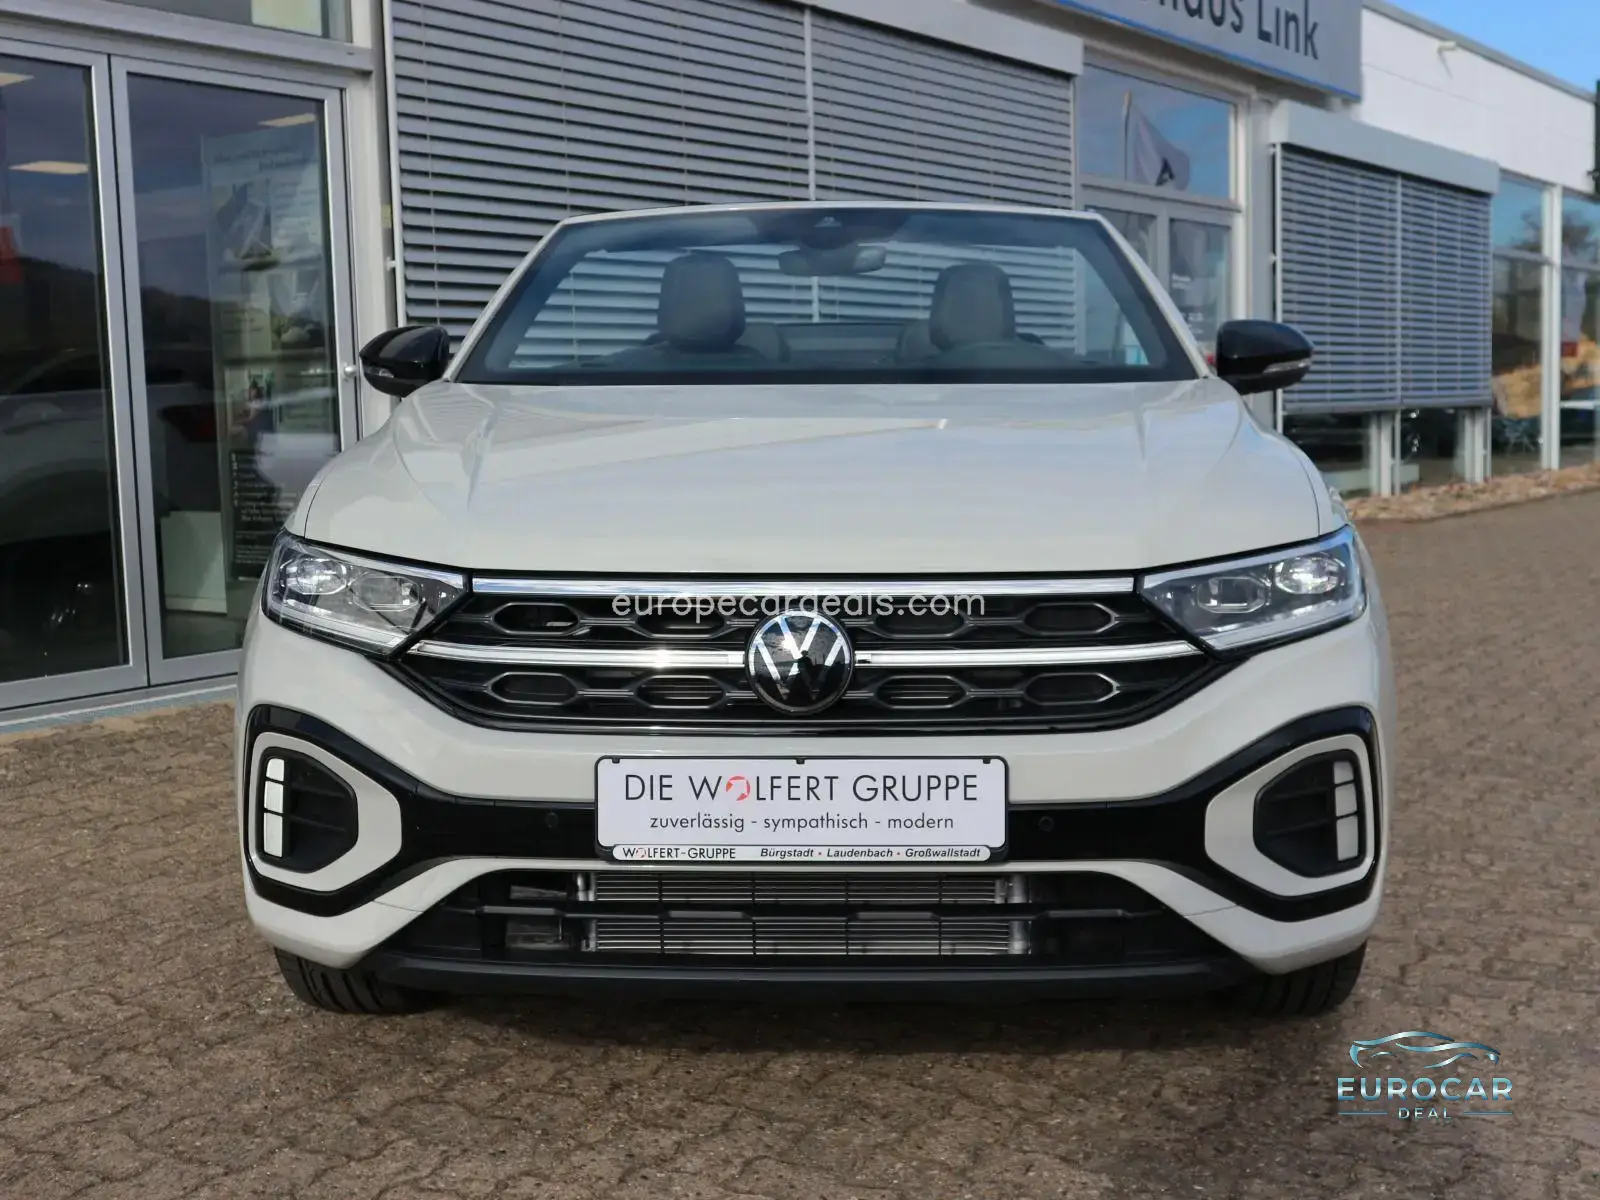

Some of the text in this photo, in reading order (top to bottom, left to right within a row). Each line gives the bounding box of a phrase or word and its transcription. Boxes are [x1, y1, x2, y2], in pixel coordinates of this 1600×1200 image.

[1258, 0, 1319, 59] Link
[625, 774, 978, 802] DIE WOLFERT GRUPPE
[650, 812, 744, 833] zuverlässig
[764, 812, 868, 833] sympathisch
[888, 812, 954, 829] modern
[760, 848, 814, 861] Bürgstadt
[827, 848, 893, 858] Laudenbach
[905, 848, 981, 858] Großwallstadt
